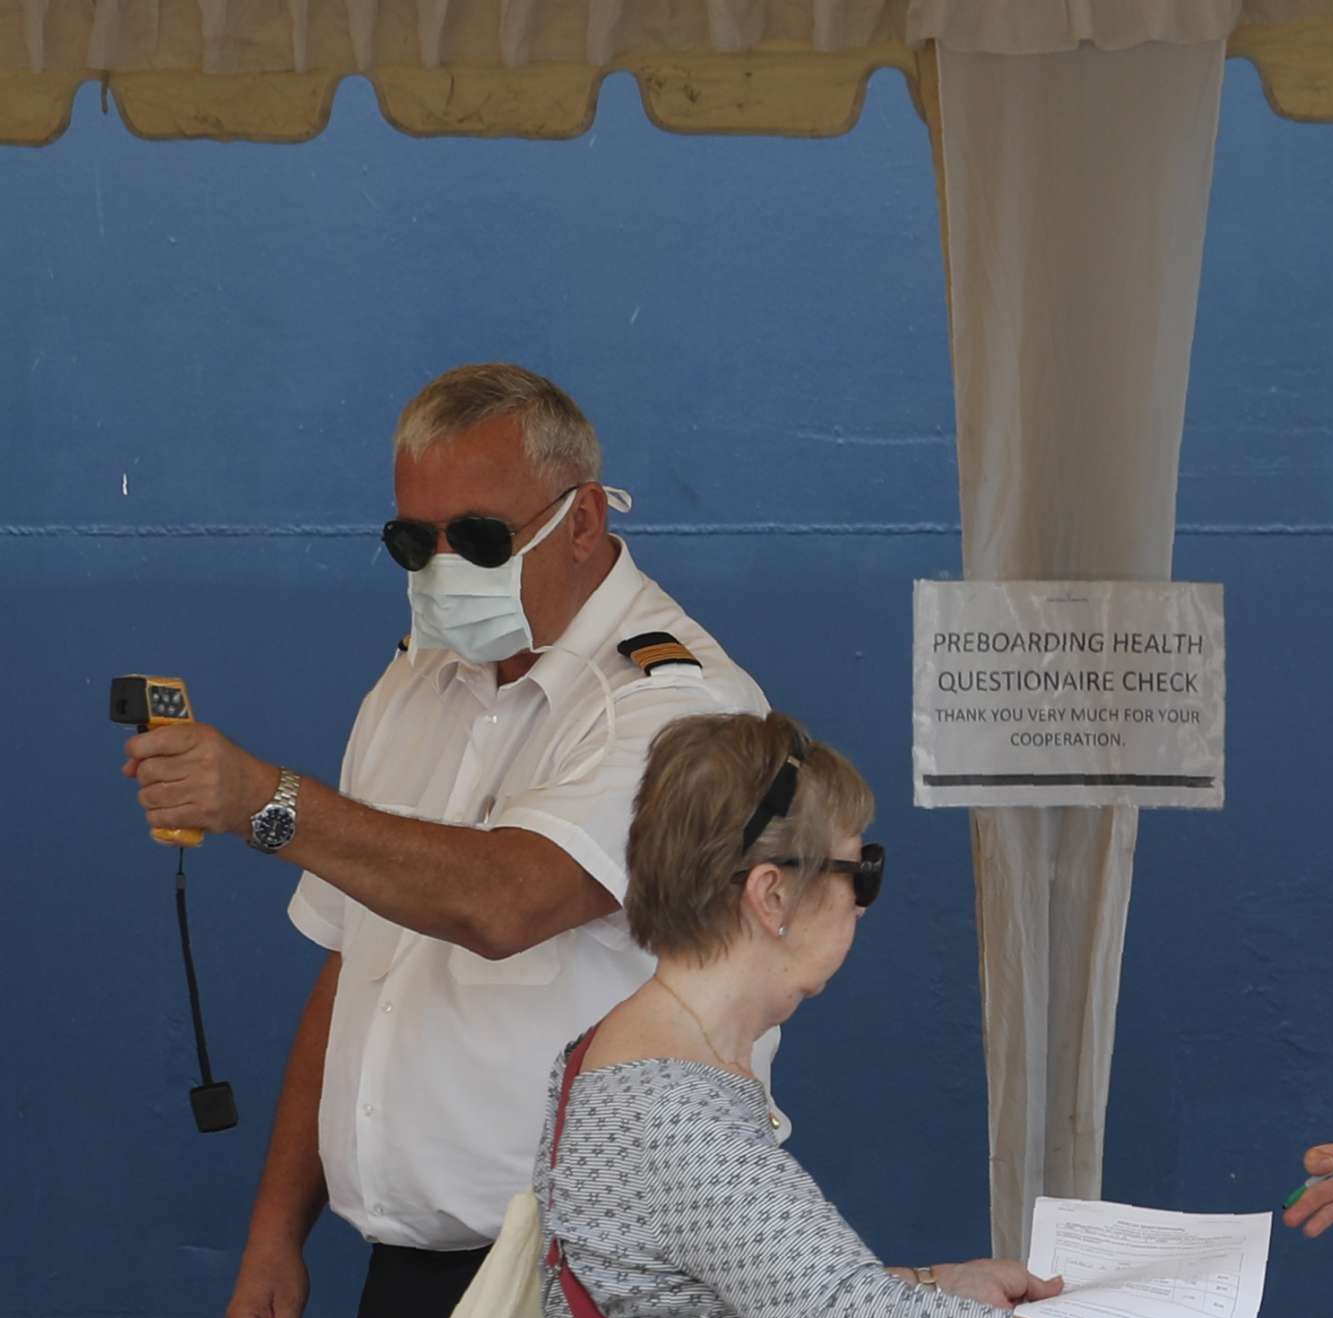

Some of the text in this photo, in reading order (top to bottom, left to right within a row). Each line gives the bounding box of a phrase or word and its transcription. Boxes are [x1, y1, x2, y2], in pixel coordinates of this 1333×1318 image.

[933, 631, 1203, 654] PREBOARDING HEALTH
[938, 670, 1199, 694] QUESTIONAIRE CHECK
[935, 707, 1201, 724] THANK YOU VERY MUCH FOR YOUR
[1010, 731, 1126, 747] COOPERATION.
